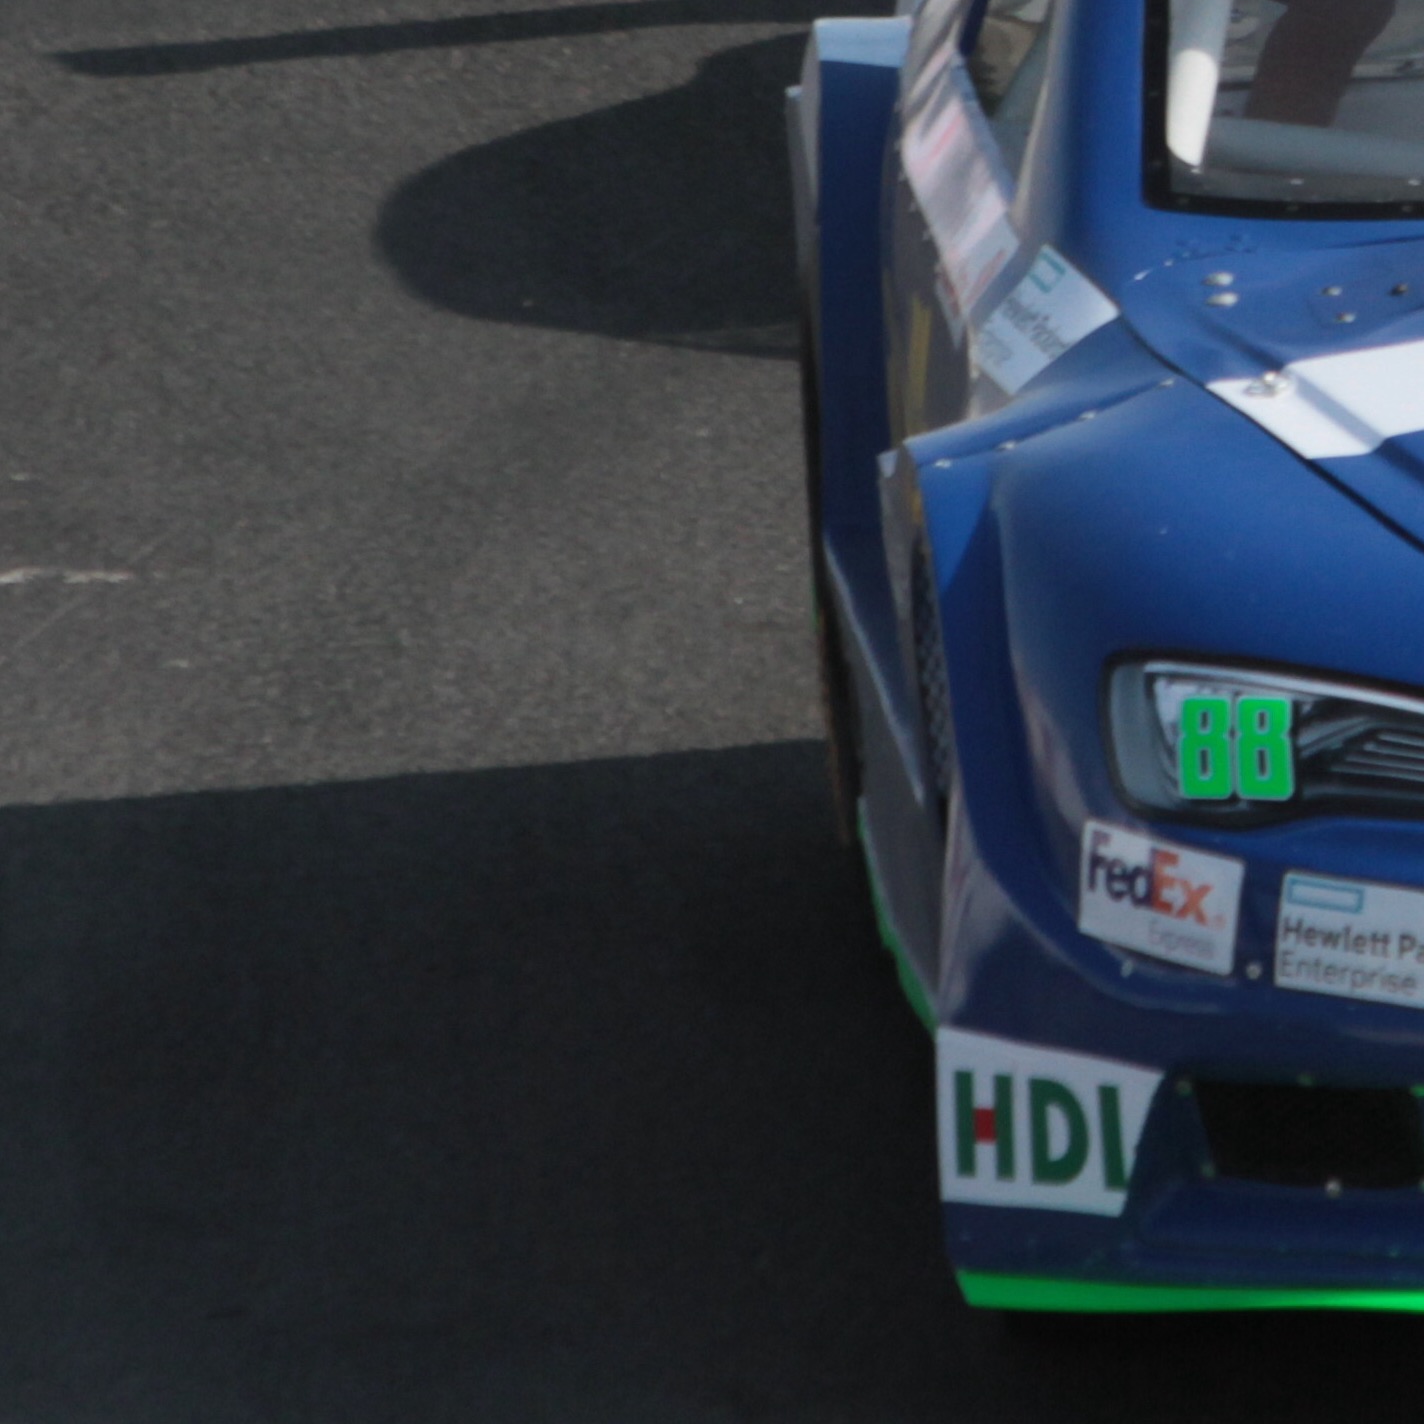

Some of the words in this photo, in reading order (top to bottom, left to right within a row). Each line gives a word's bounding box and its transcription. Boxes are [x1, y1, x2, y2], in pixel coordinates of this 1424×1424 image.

[1177, 697, 1295, 801] 88
[1086, 829, 1216, 927] FedEx
[1278, 949, 1418, 997] Enterprise
[1281, 917, 1392, 959] Hewlett
[953, 1070, 1130, 1192] HDI
